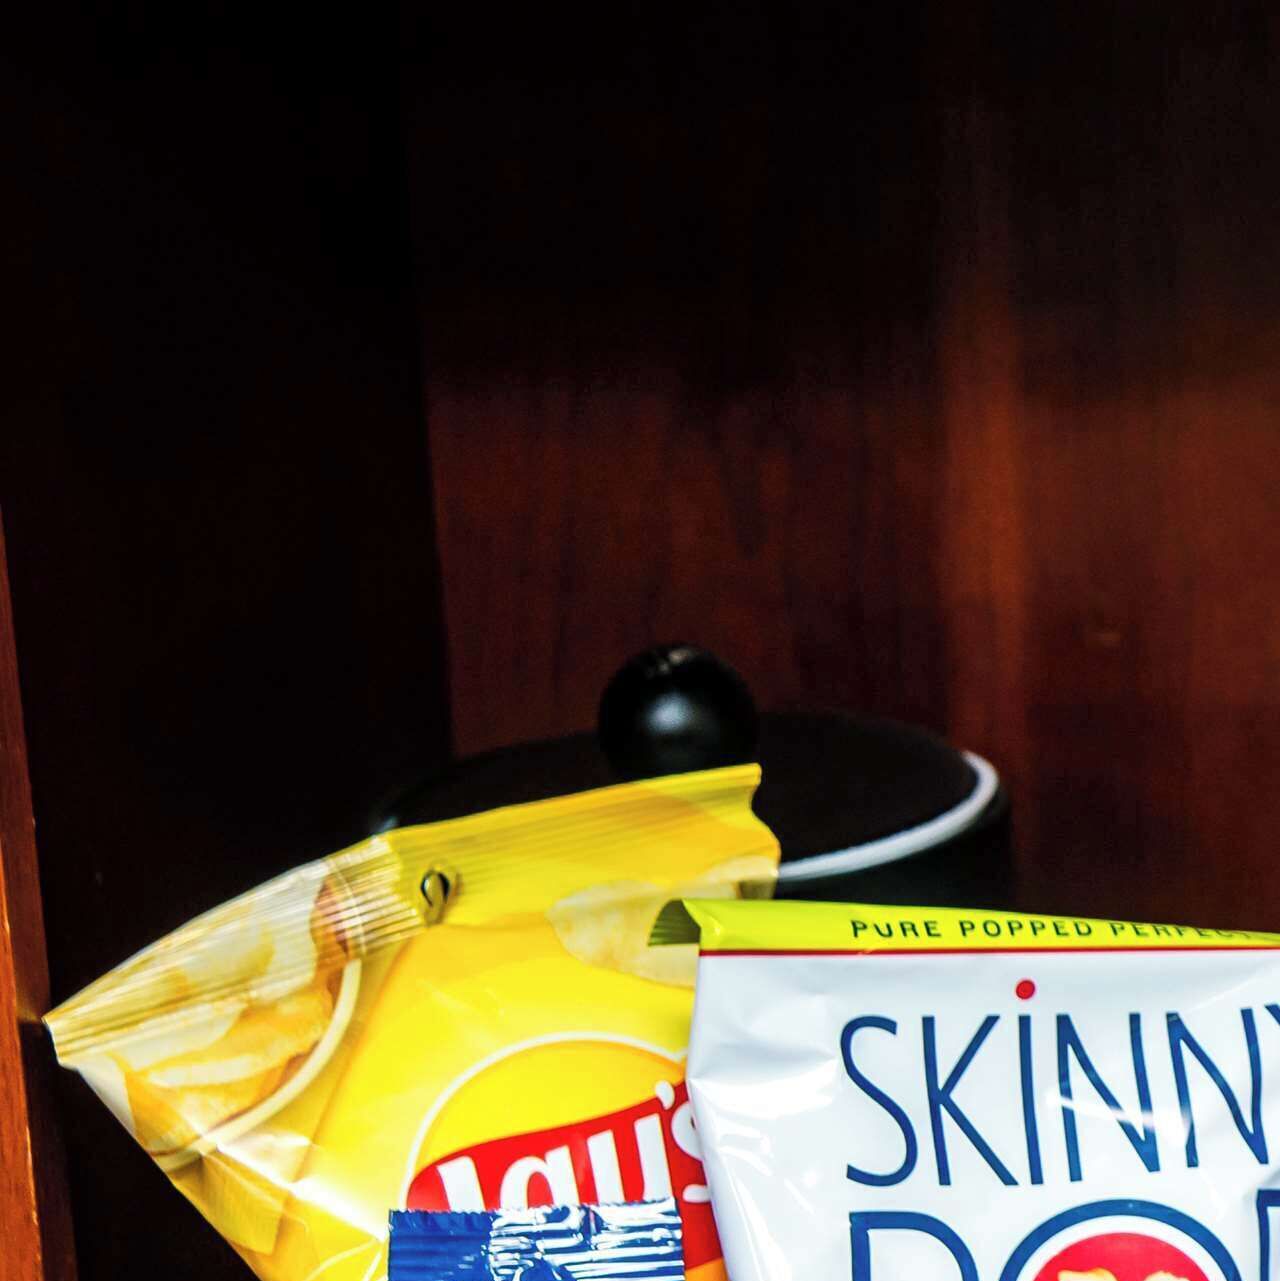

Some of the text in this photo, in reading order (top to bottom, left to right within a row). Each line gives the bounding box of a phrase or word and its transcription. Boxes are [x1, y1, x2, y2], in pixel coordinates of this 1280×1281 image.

[850, 918, 1253, 940] PURE POPPED PERFECT
